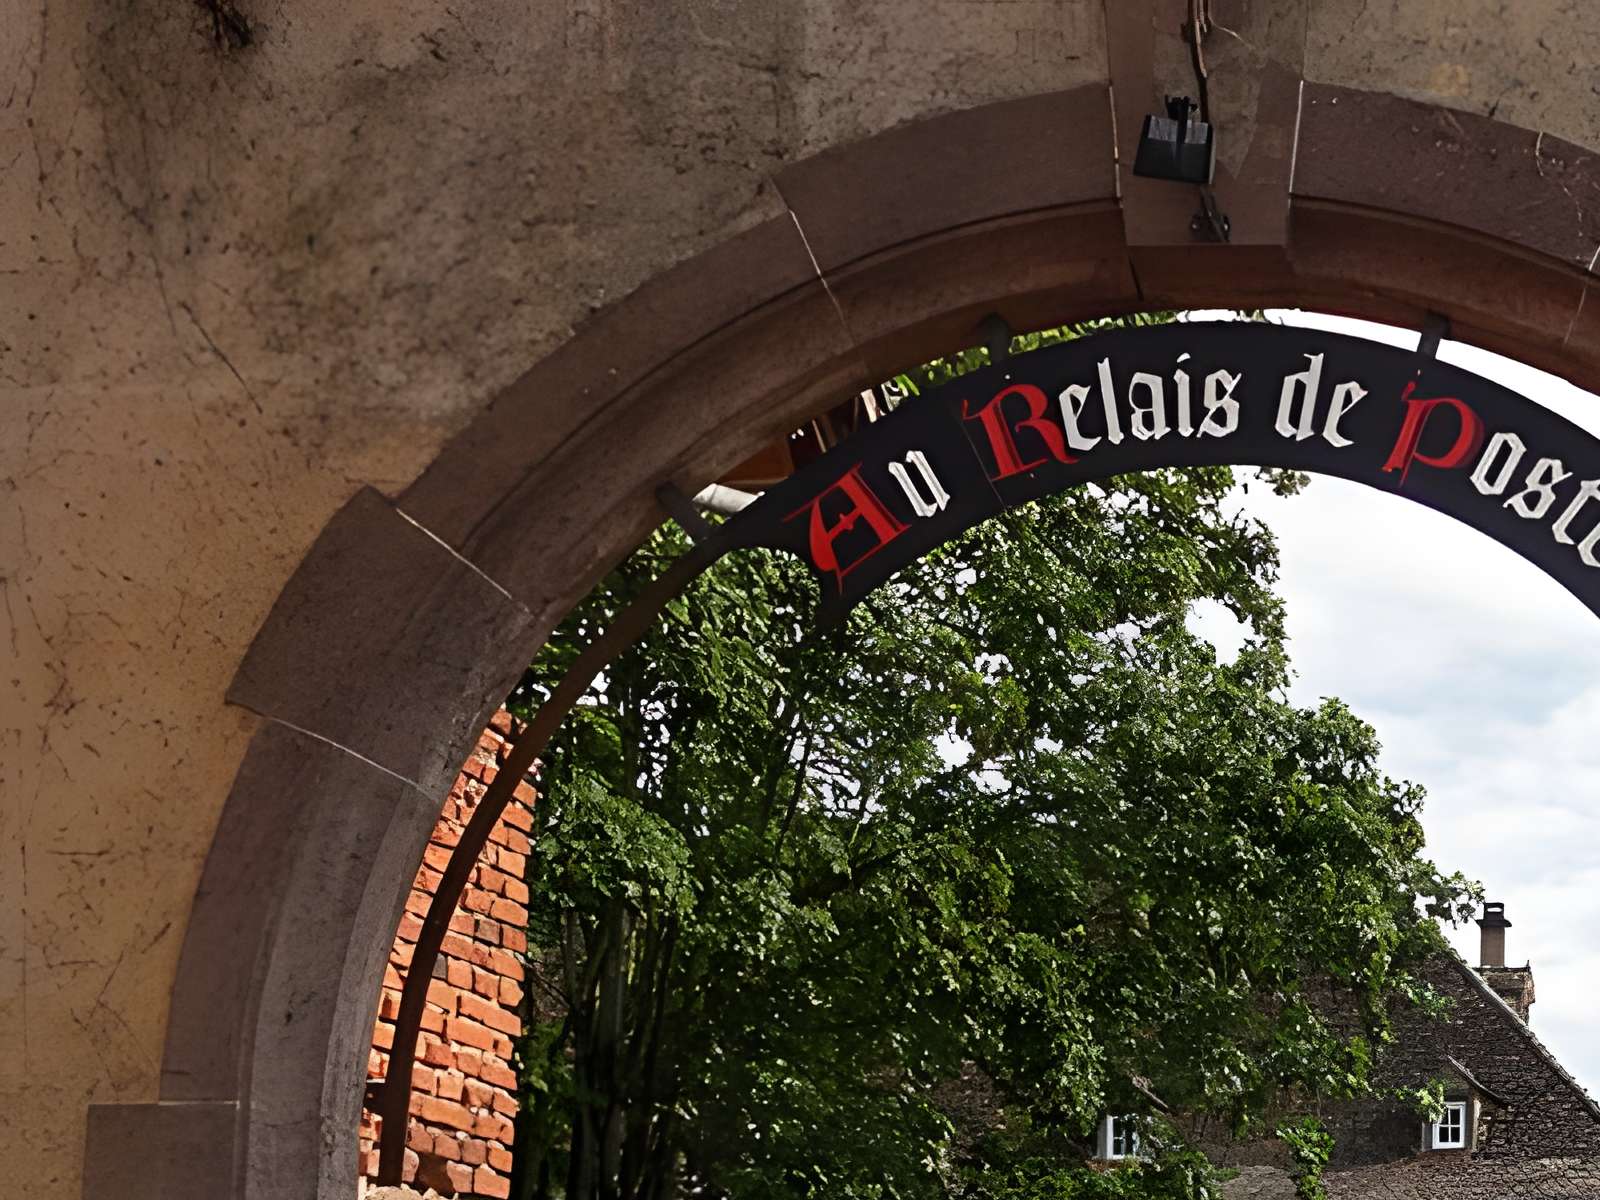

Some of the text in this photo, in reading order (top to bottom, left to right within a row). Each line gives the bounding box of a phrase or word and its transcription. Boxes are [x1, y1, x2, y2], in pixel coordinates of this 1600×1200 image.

[783, 449, 951, 594] Au
[963, 353, 1242, 481] Relais
[1274, 352, 1368, 448] de
